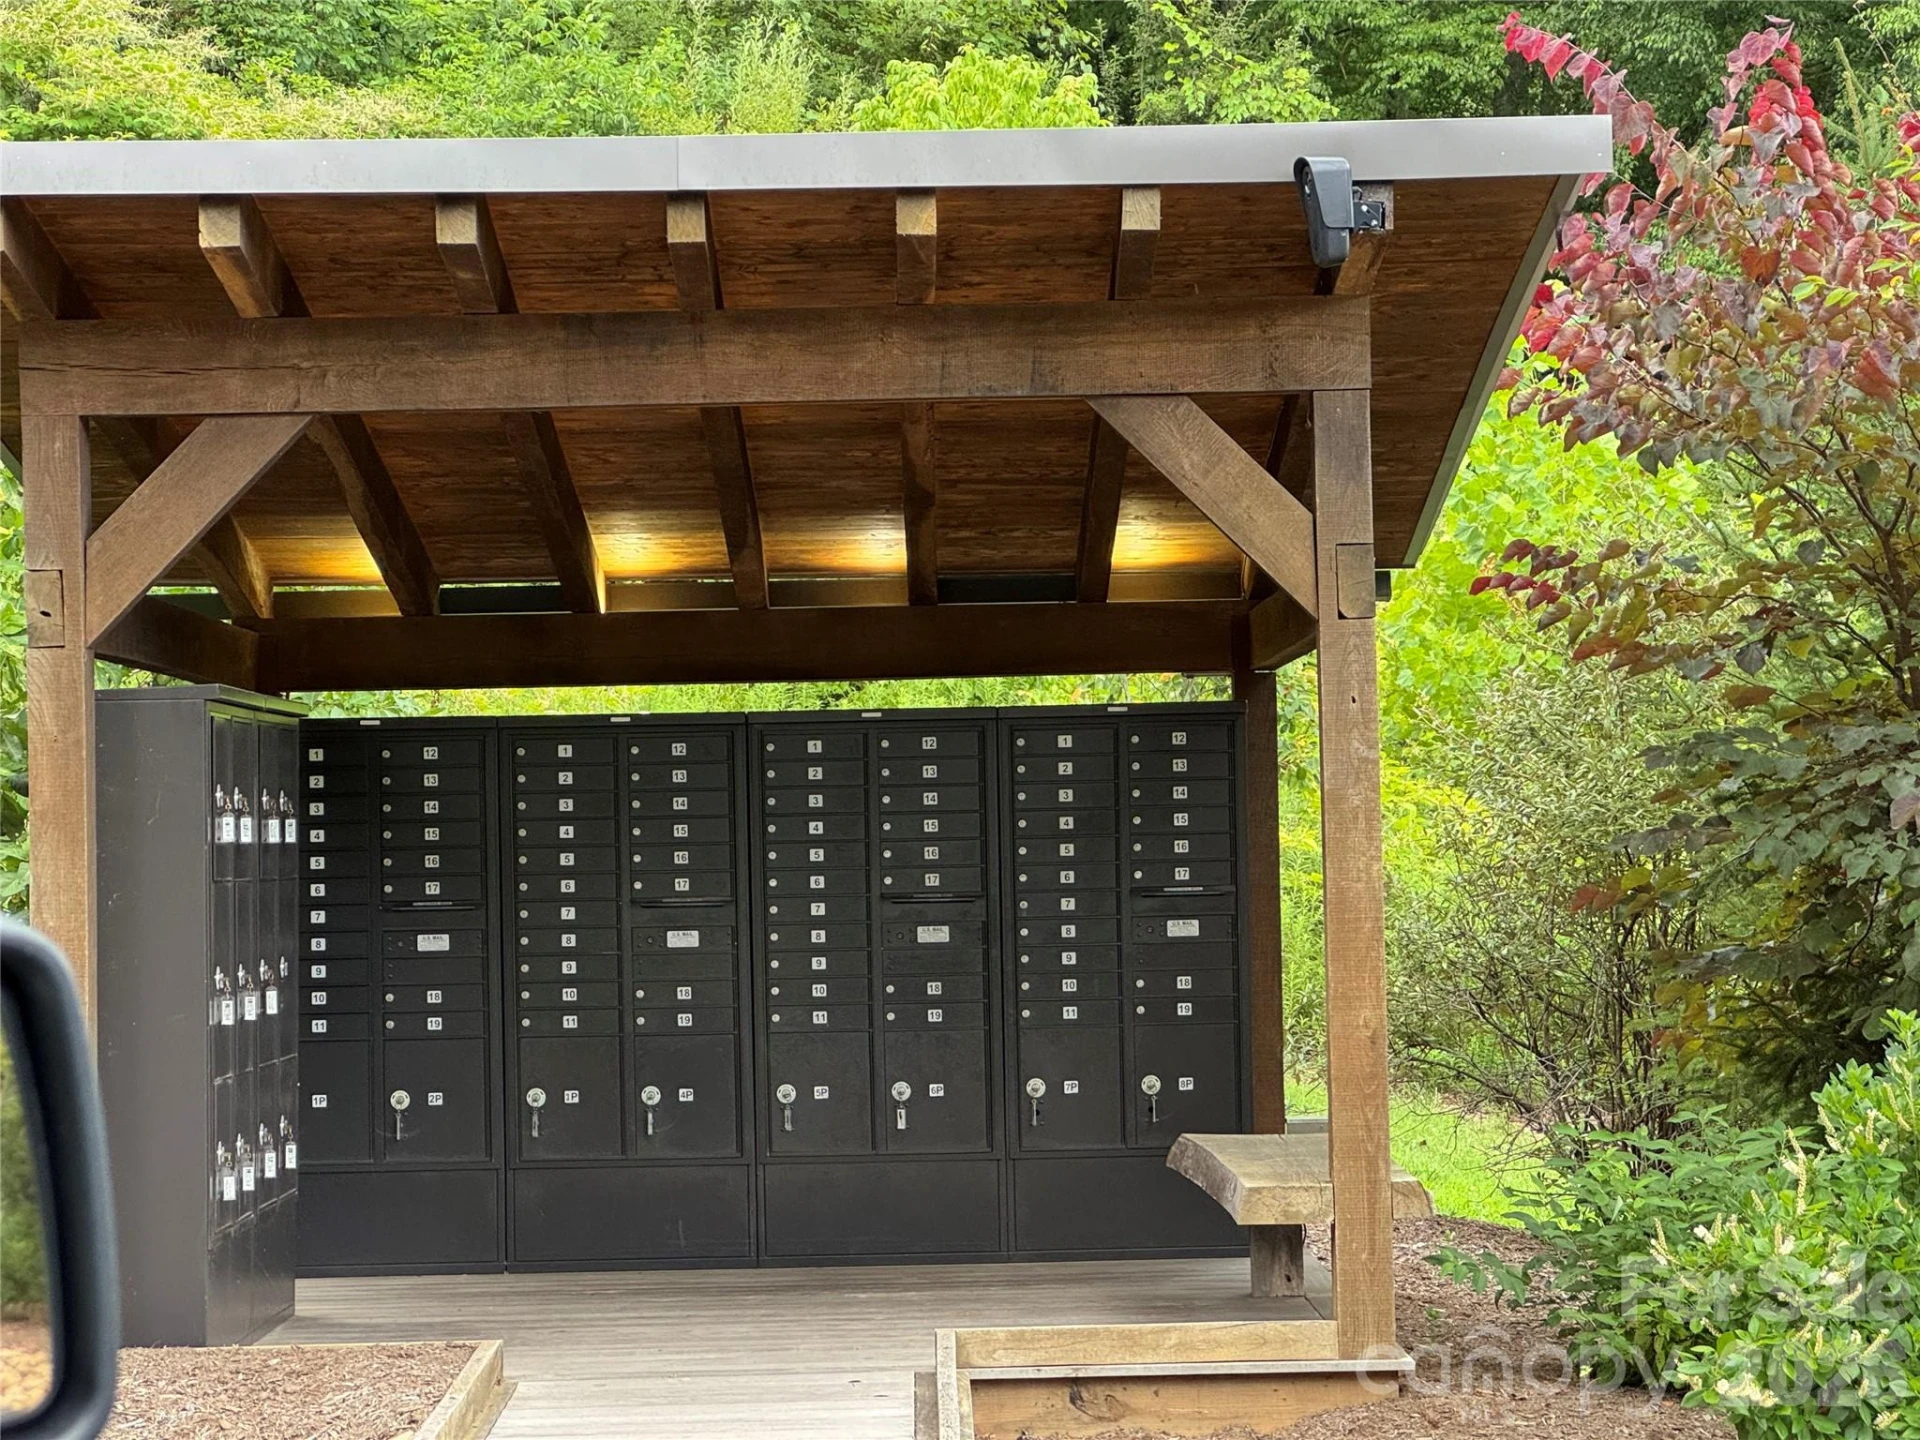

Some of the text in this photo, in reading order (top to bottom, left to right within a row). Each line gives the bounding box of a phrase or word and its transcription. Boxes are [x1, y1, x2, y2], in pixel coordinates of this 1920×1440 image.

[1174, 734, 1185, 743] 12
[924, 739, 935, 748] 12
[425, 748, 437, 758] 12
[674, 745, 685, 754] 12
[1062, 764, 1069, 773] 2
[1174, 760, 1186, 770] 13
[674, 771, 685, 781] 13
[812, 769, 819, 778] 2
[925, 767, 936, 776] 13
[313, 777, 320, 787] 2
[425, 775, 437, 785] 13
[562, 774, 569, 783] 2
[1063, 790, 1069, 800] 3
[1175, 788, 1186, 796] 14
[813, 796, 819, 806] 3
[925, 794, 936, 803] 14
[426, 803, 437, 811] 14
[563, 800, 569, 810] 3
[675, 799, 686, 808] 14
[314, 804, 320, 814] 3
[1063, 818, 1070, 827] 4
[1175, 815, 1187, 824] 15
[812, 823, 819, 832] 4
[925, 821, 937, 830] 15
[426, 829, 438, 839] 15
[563, 828, 570, 836] 4
[675, 826, 687, 835] 15
[314, 832, 320, 840] 4
[1064, 845, 1071, 854] 5
[1176, 841, 1187, 851] 16
[814, 850, 821, 860] 5
[926, 848, 937, 857] 16
[426, 857, 438, 866] 16
[564, 854, 571, 864] 5
[676, 853, 687, 862] 16
[314, 858, 321, 868] 5
[1064, 872, 1071, 882] 6
[1177, 869, 1188, 878] 17
[814, 877, 821, 887] 6
[927, 875, 938, 884] 17
[427, 883, 439, 892] 17
[564, 881, 571, 891] 6
[676, 880, 688, 889] 17
[314, 885, 321, 895] 6
[1065, 899, 1071, 908] 7
[565, 908, 571, 917] 7
[815, 904, 821, 913] 7
[315, 912, 321, 921] 7
[1065, 927, 1072, 936] 8
[565, 936, 572, 945] 8
[815, 932, 822, 941] 8
[315, 940, 322, 949] 8
[1065, 953, 1072, 963] 9
[566, 963, 573, 972] 9
[815, 958, 822, 968] 9
[315, 967, 322, 976] 9
[1064, 980, 1075, 990] 10
[1179, 978, 1190, 987] 18
[679, 988, 690, 998] 18
[814, 986, 825, 995] 10
[929, 984, 940, 993] 18
[313, 994, 325, 1003] 10
[429, 992, 440, 1001] 18
[565, 990, 576, 999] 10
[1065, 1008, 1076, 1017] 11
[1179, 1004, 1190, 1014] 19
[679, 1015, 691, 1025] 19
[815, 1013, 825, 1022] 11
[930, 1011, 941, 1020] 19
[314, 1022, 325, 1031] 11
[429, 1019, 441, 1028] 19
[566, 1018, 576, 1026] 11
[1065, 1082, 1077, 1091] 7P
[1180, 1079, 1192, 1088] 8P
[680, 1090, 692, 1099] 4P
[816, 1088, 828, 1097] 5P
[931, 1085, 943, 1095] 6P
[314, 1096, 326, 1105] 1P
[429, 1094, 442, 1104] 2P
